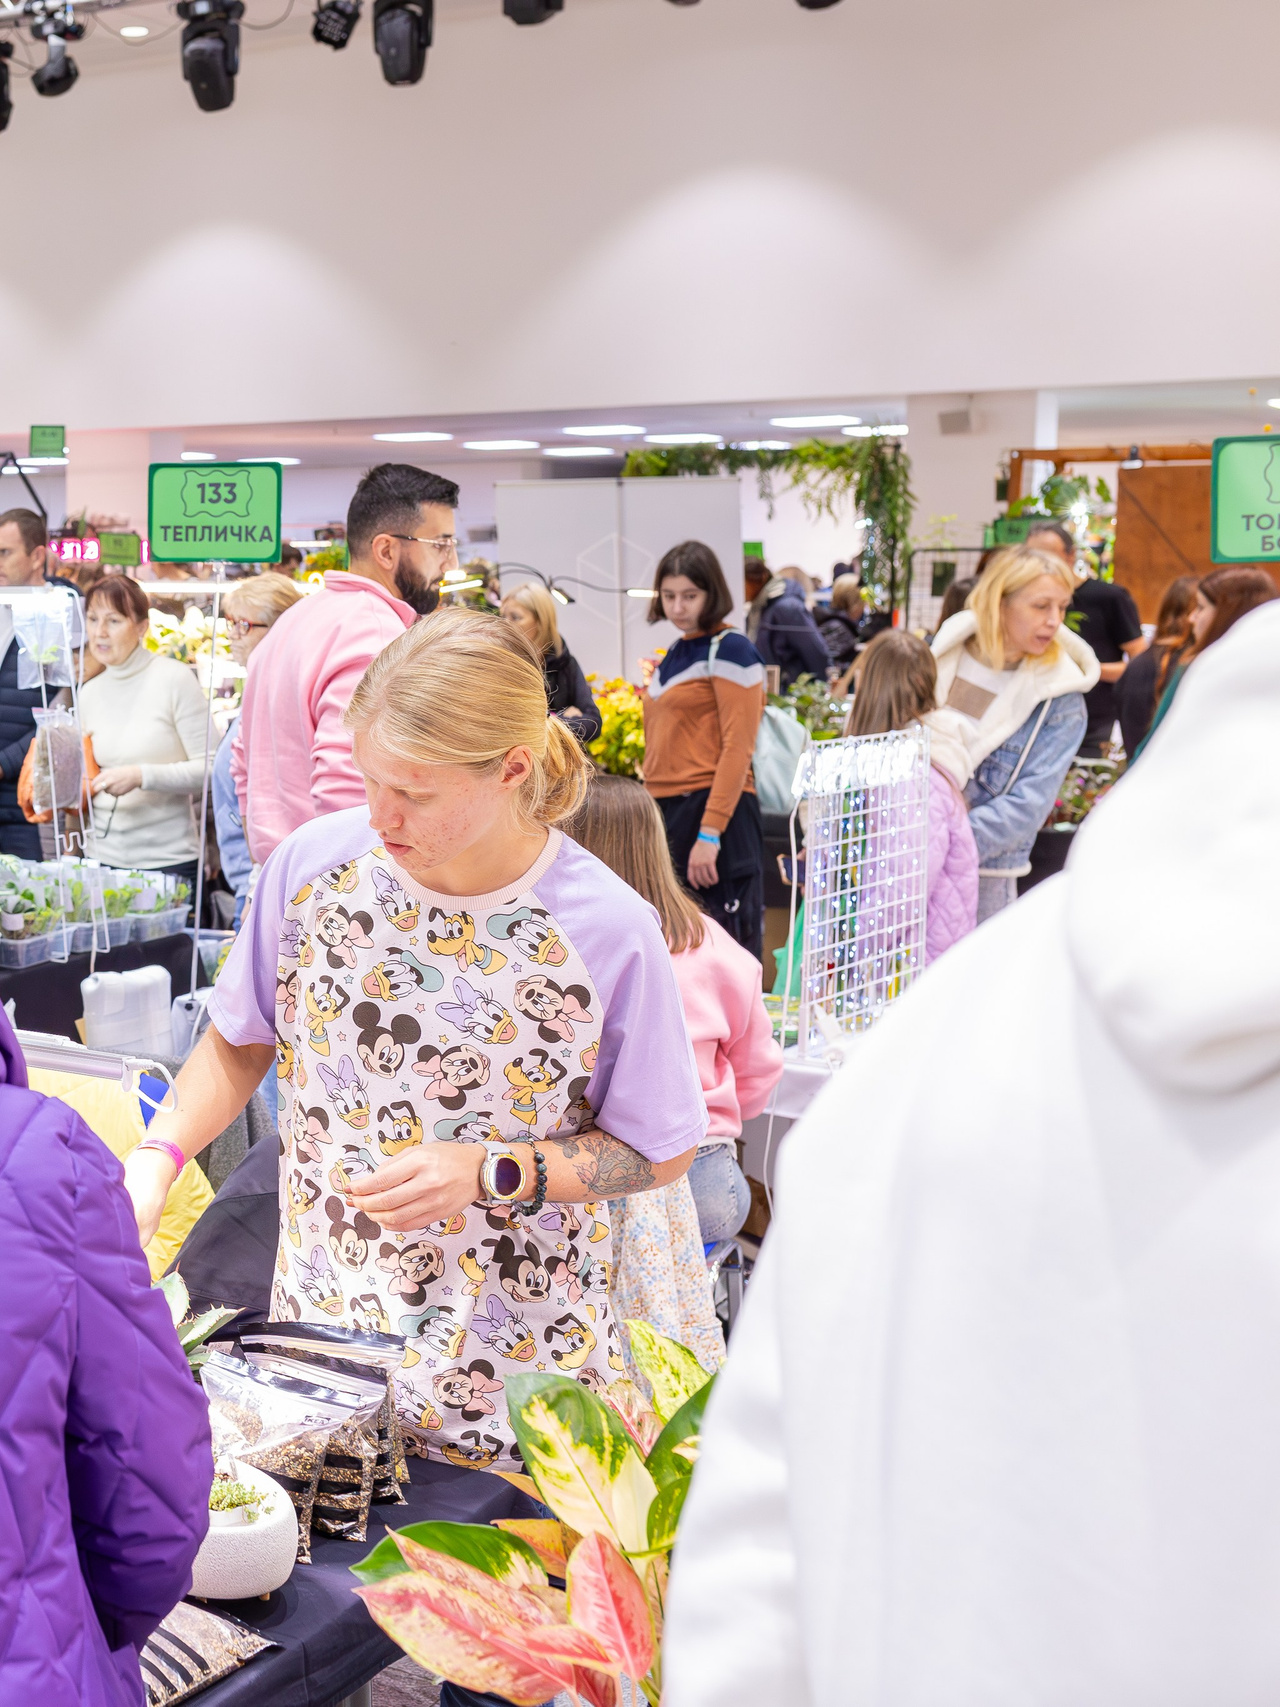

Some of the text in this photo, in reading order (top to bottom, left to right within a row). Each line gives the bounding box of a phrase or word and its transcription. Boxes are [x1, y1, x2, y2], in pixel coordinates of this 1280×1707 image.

[197, 482, 237, 504] 133
[1241, 513, 1280, 531] ТО
[160, 525, 274, 543] ТЕПЛИЧКА
